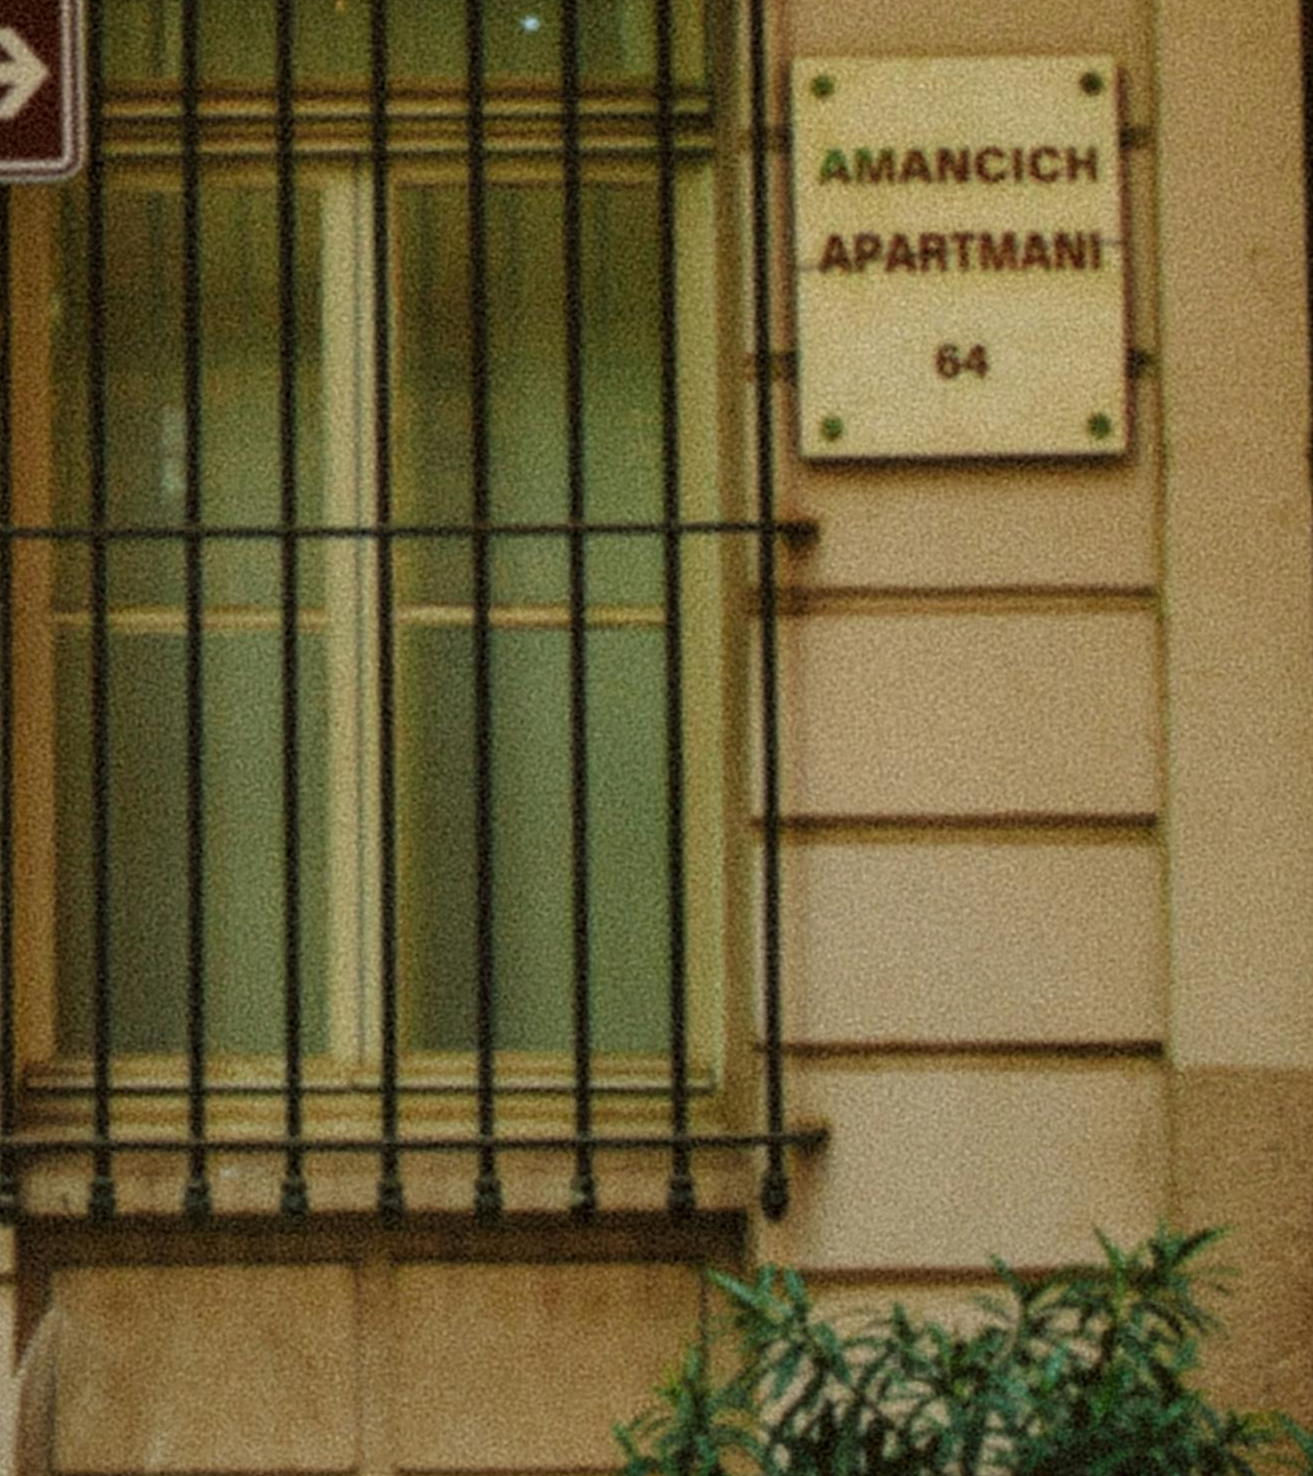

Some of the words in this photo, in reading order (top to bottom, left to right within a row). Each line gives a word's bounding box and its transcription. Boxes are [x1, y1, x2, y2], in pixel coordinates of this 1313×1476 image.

[819, 145, 1099, 185] AMANCICH
[817, 231, 1104, 274] APARTMANI
[934, 343, 991, 381] 64
